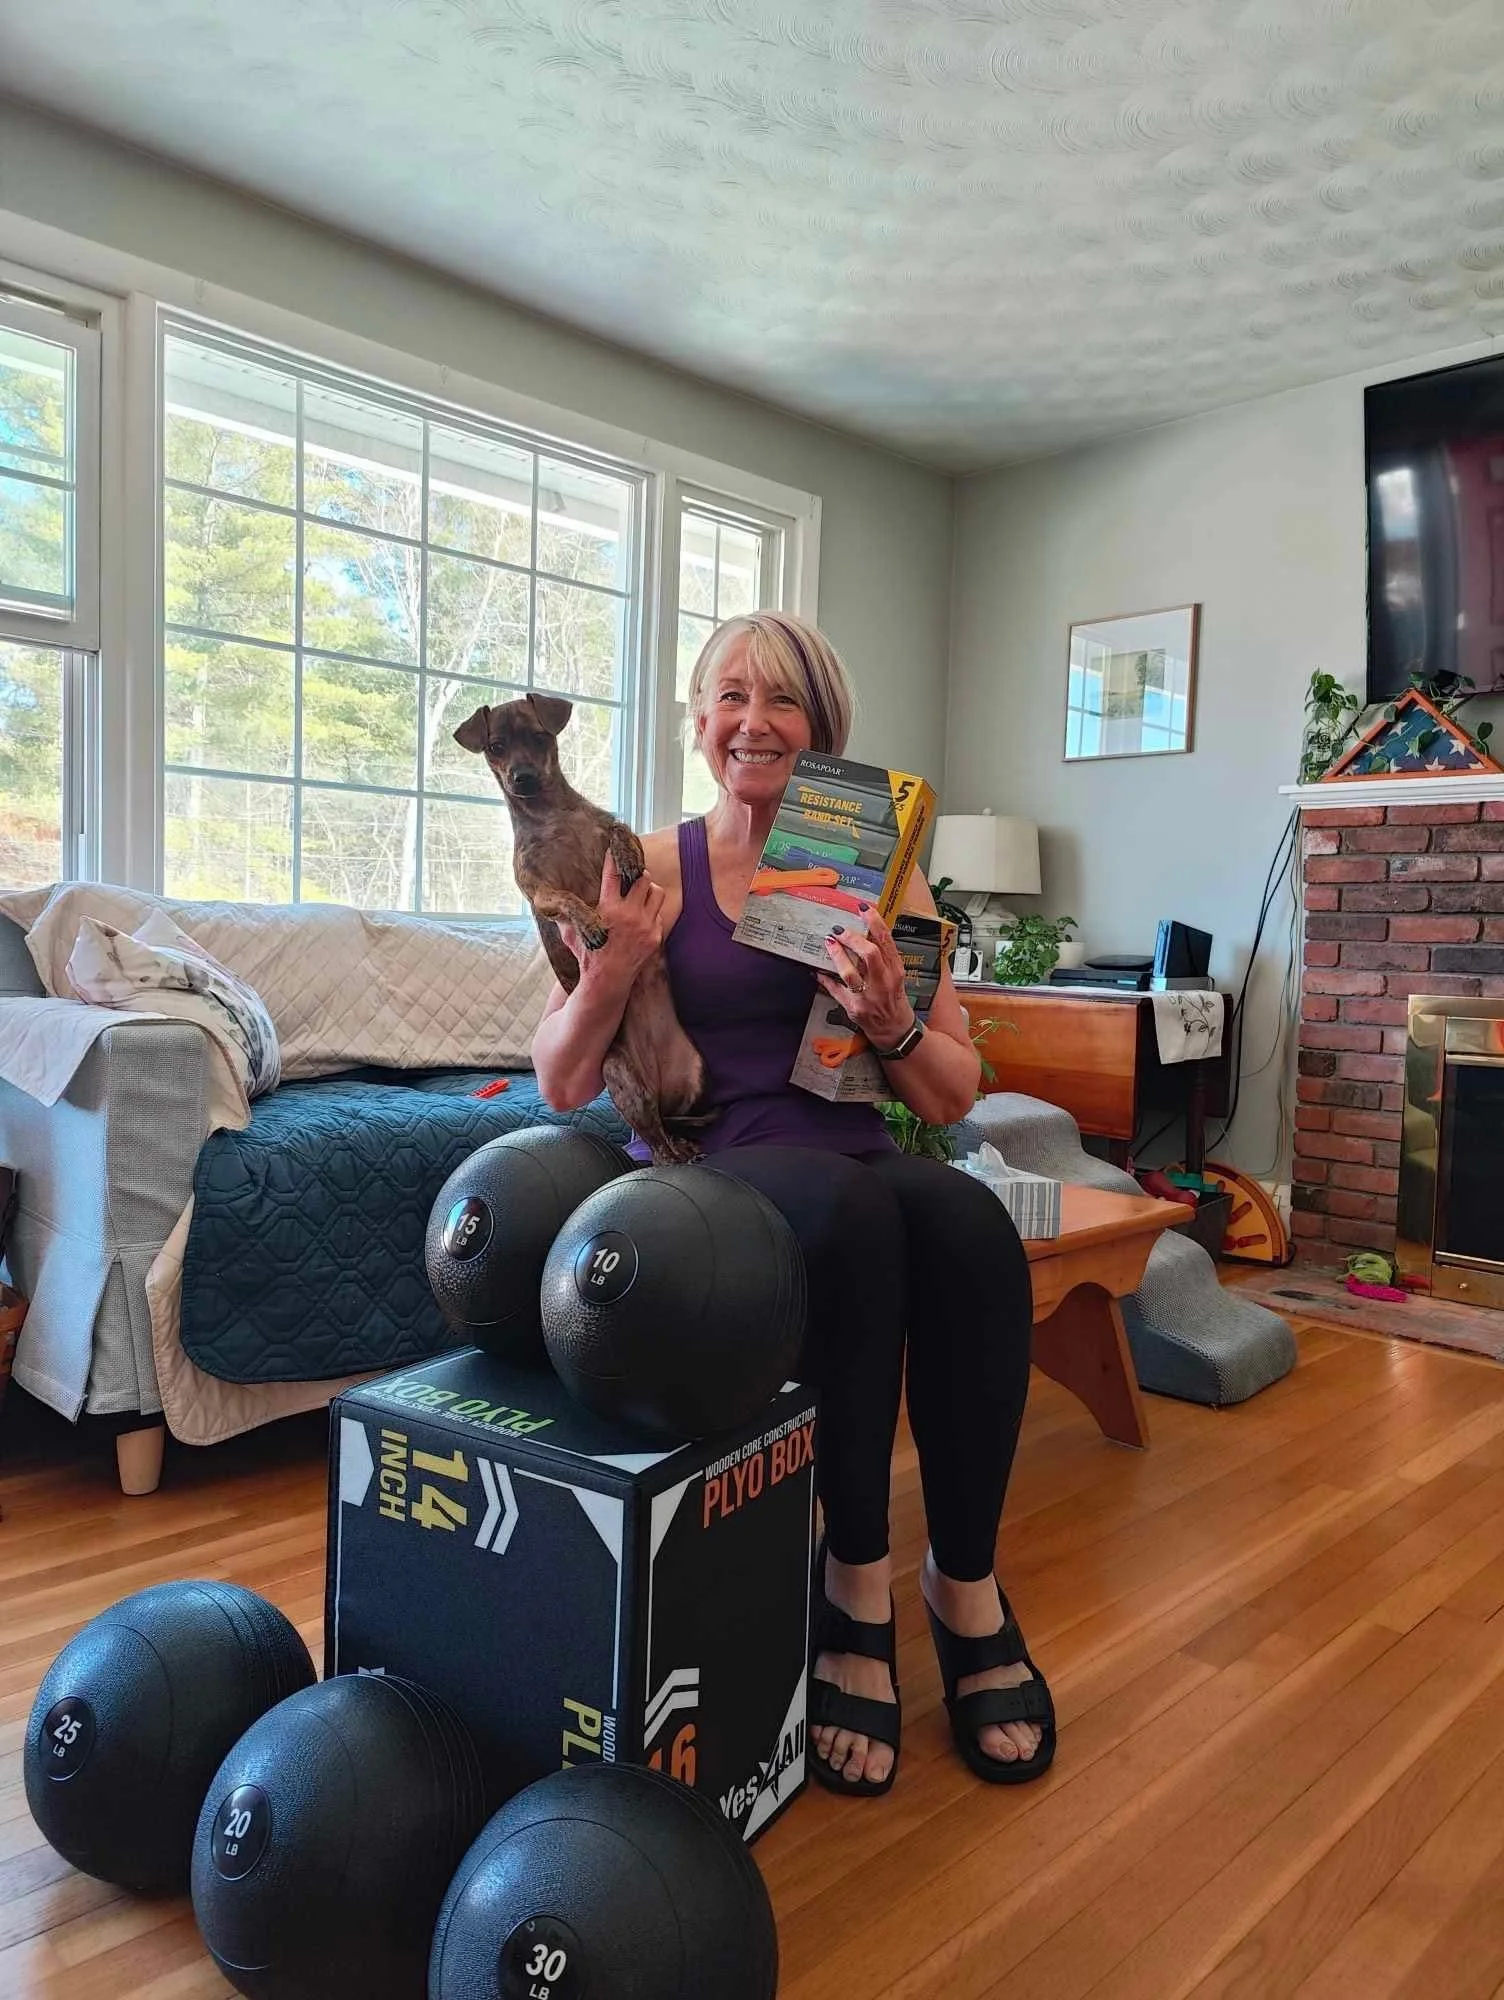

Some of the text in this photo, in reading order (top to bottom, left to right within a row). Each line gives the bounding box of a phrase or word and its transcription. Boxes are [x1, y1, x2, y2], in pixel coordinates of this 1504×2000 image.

[895, 780, 915, 802] 5
[800, 791, 863, 814] RESISTANCE
[834, 814, 853, 827] SET
[942, 928, 954, 949] 5
[457, 1213, 481, 1235] 15
[456, 1236, 468, 1247] LB
[592, 1248, 621, 1273] 10
[590, 1273, 606, 1286] LB
[371, 1377, 555, 1434] PLYO BOX
[471, 1417, 523, 1439] WOODEN
[705, 1405, 817, 1481] WOODEN CORE CONSTRUCTION
[379, 1428, 408, 1522] INCH
[703, 1420, 816, 1529] PLYO BOX
[411, 1448, 469, 1532] 14
[54, 1714, 83, 1745] 25
[53, 1743, 66, 1758] LB
[223, 1807, 251, 1839] 20
[225, 1843, 239, 1857] LB
[525, 1943, 567, 1982] 30
[528, 1983, 550, 2000] LB
